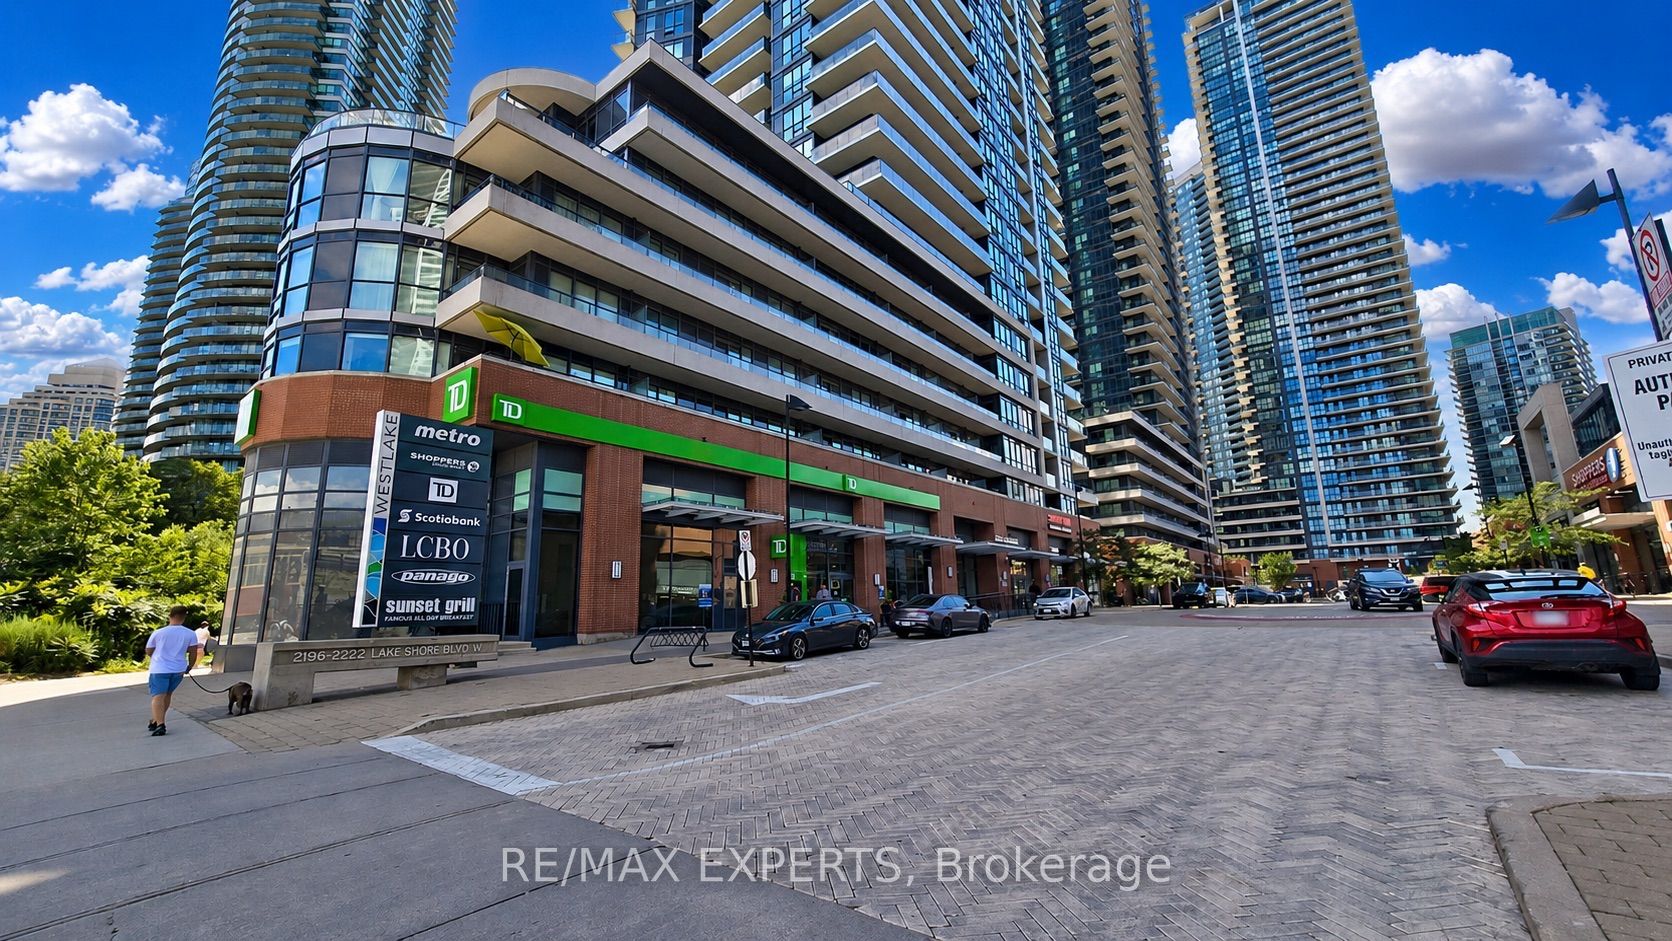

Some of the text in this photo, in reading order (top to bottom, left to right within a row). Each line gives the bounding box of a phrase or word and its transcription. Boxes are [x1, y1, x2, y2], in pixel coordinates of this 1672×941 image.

[448, 379, 467, 414] TD
[499, 399, 522, 420] TD
[414, 424, 481, 446] metro
[375, 414, 398, 515] WESTLAKE
[410, 452, 466, 466] SHOPPERS
[433, 482, 454, 498] TD
[847, 477, 857, 490] TD
[400, 534, 470, 560] LCBO
[772, 539, 787, 554] TD
[400, 571, 469, 583] panago
[385, 597, 476, 615] sunset grill
[293, 644, 482, 663] 2196-2222 LAKE SHORE BLVD W
